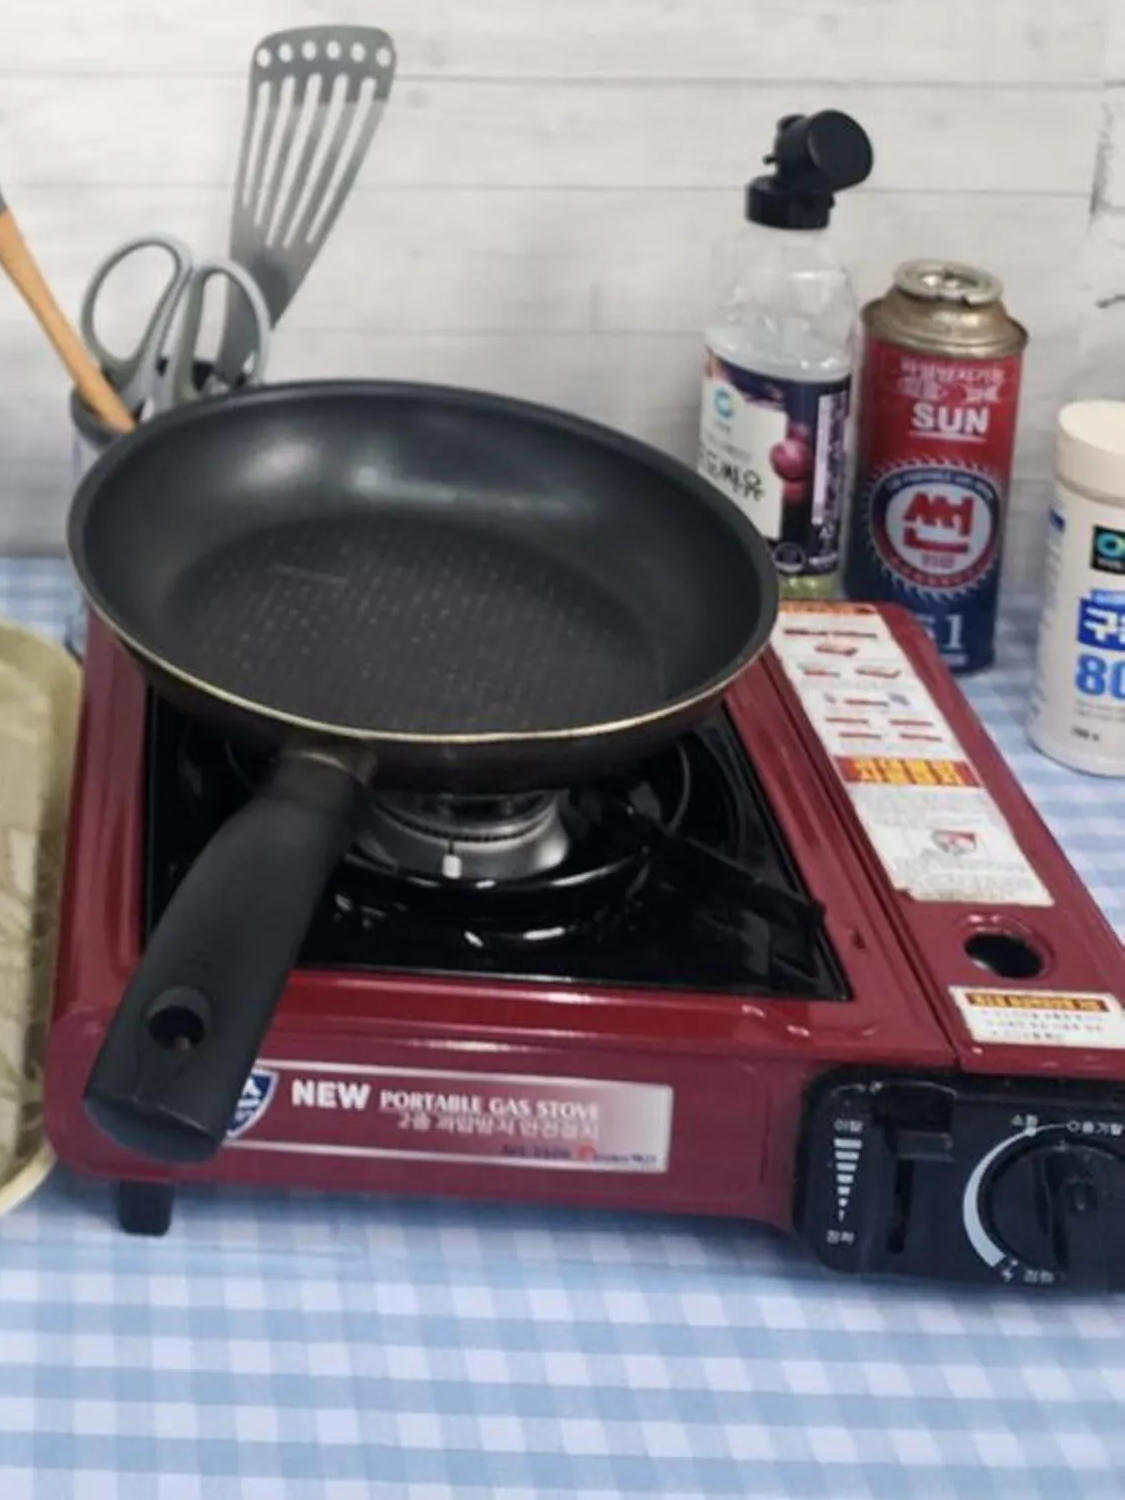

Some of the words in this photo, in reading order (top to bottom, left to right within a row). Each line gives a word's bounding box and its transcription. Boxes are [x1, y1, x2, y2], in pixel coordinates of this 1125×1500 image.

[911, 402, 990, 434] SUN
[292, 1079, 371, 1110] NEW
[380, 1090, 481, 1116] PORTABLE
[488, 1097, 530, 1115] GAS
[536, 1100, 599, 1121] STOVE
